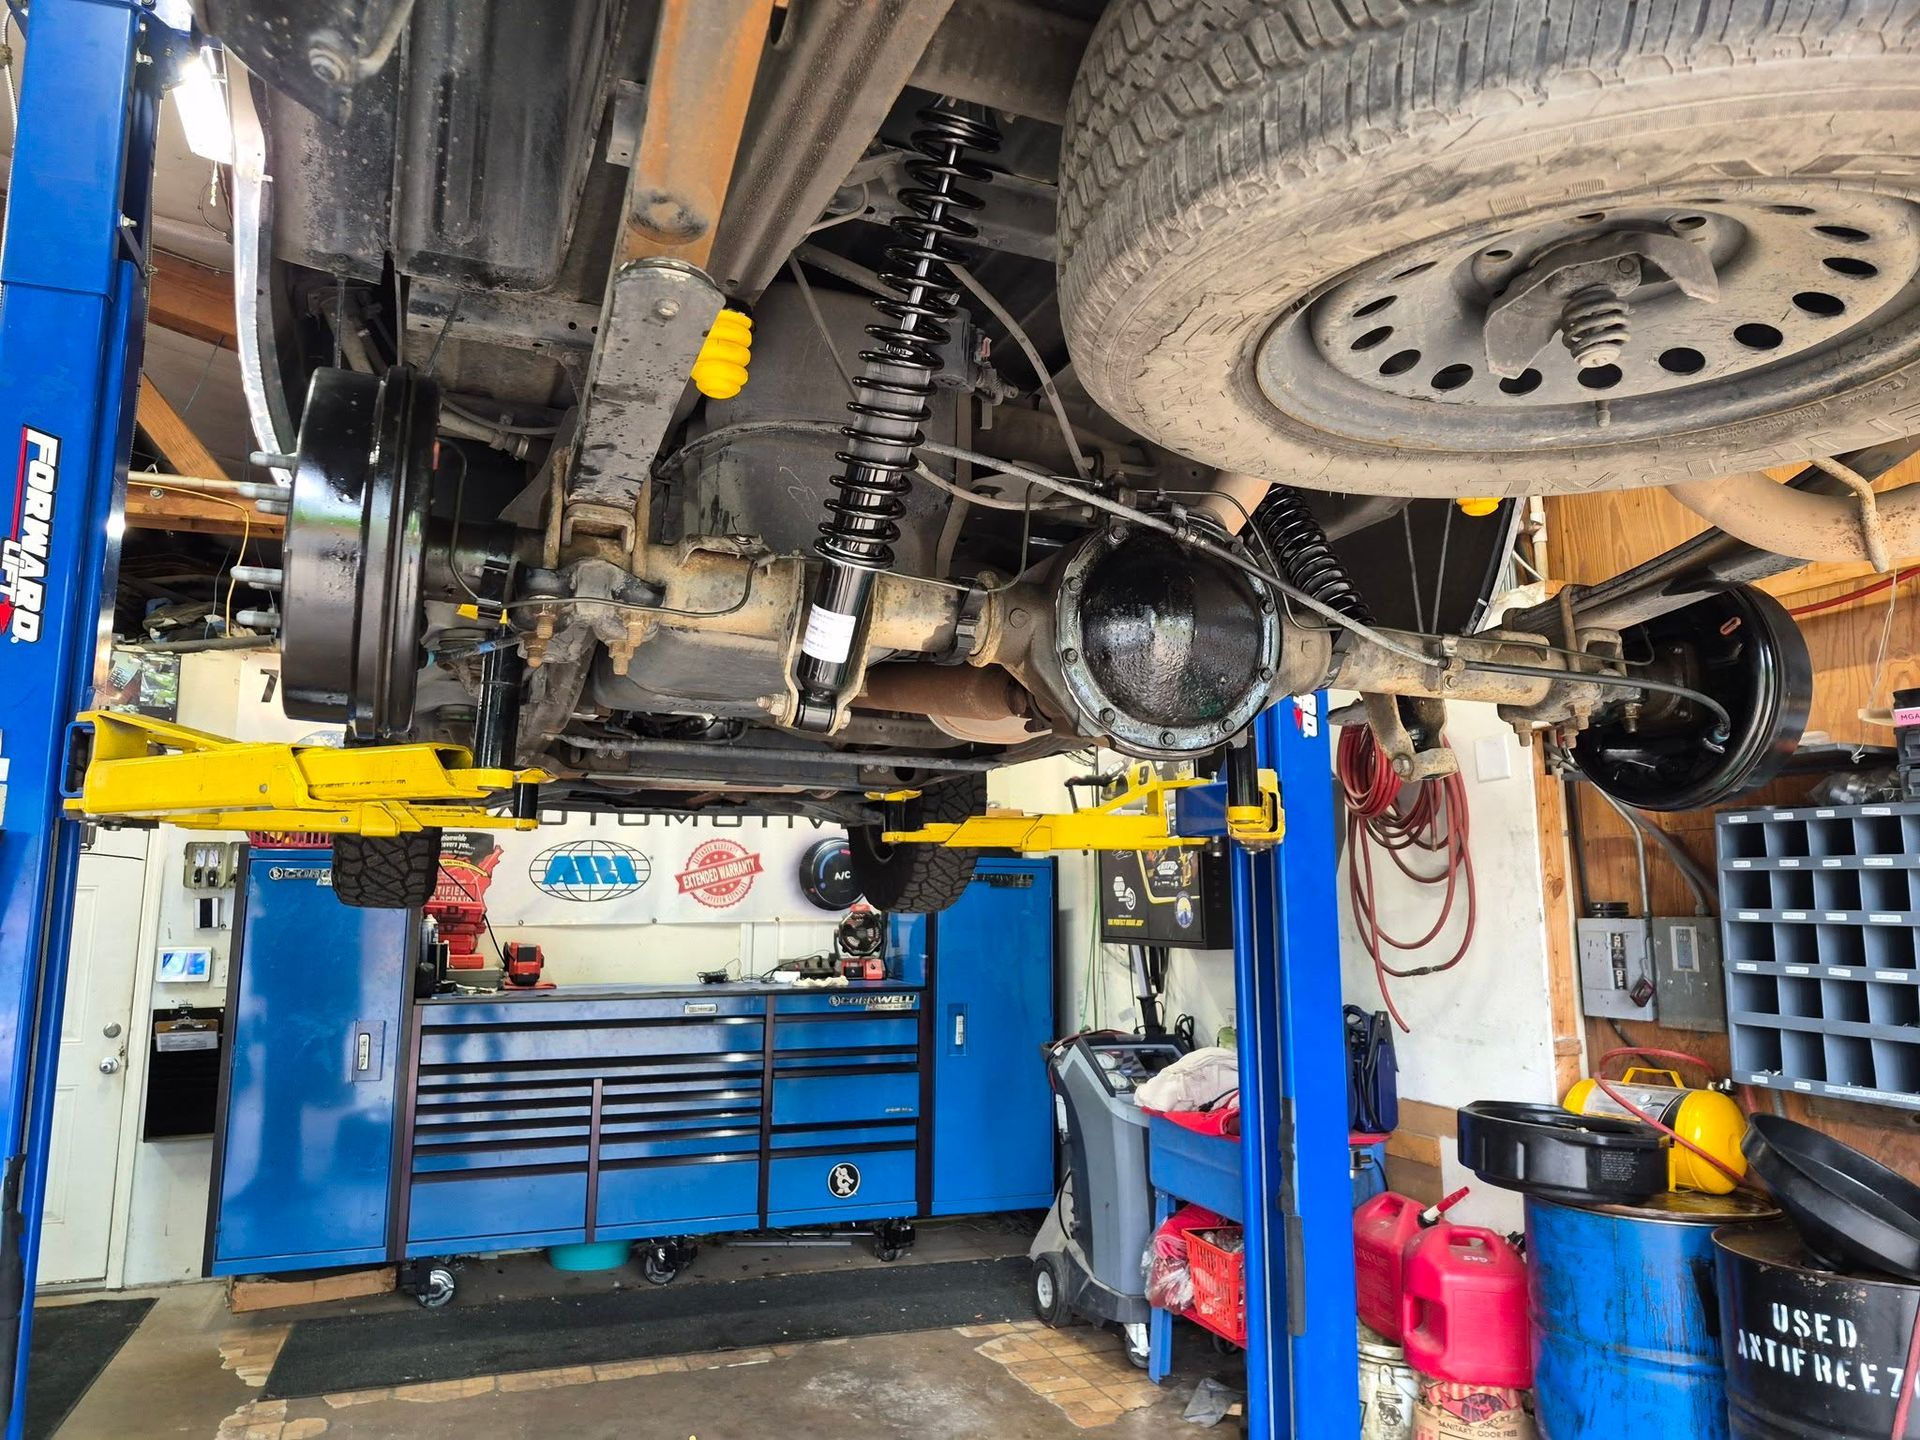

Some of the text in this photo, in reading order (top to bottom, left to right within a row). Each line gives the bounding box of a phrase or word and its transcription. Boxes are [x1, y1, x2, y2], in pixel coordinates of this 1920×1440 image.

[12, 424, 62, 643] FORWARD
[682, 857, 756, 890] EXTENDED WARRANTY
[834, 870, 851, 881] A/C
[1772, 1302, 1857, 1348] USED
[1738, 1328, 1920, 1399] ANTIFREEZ
